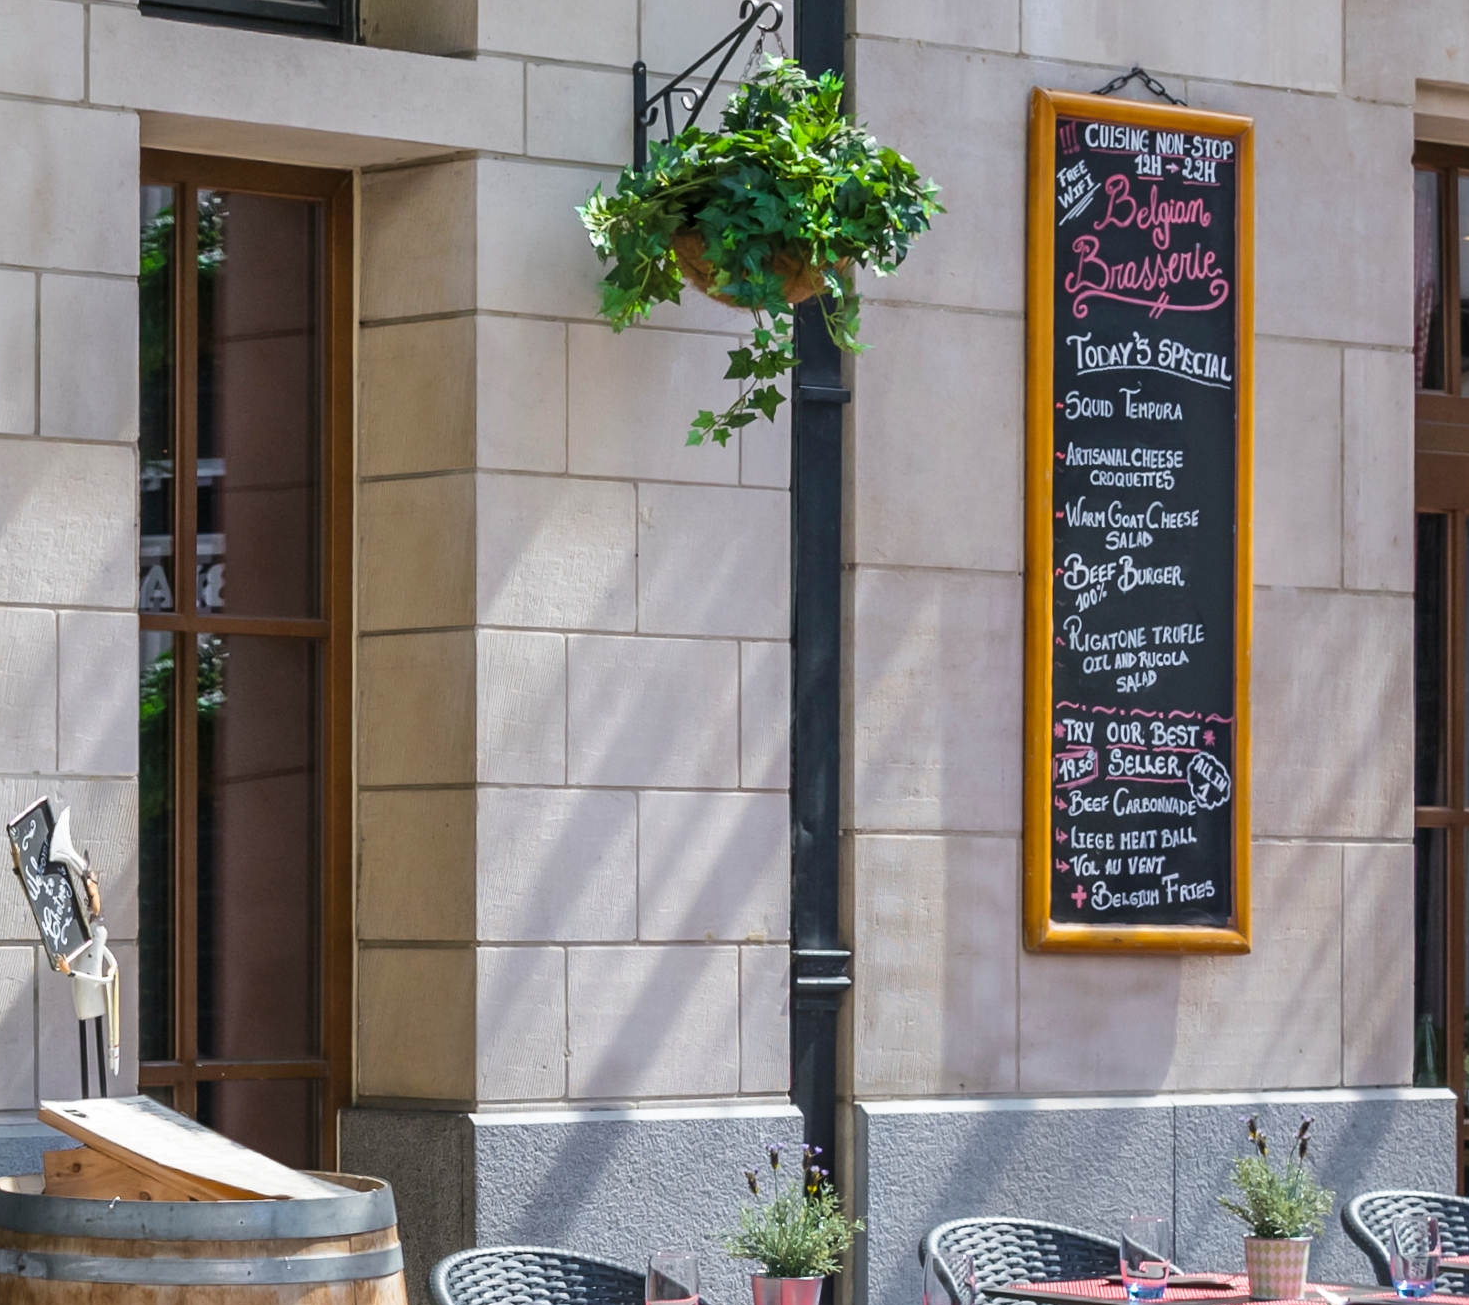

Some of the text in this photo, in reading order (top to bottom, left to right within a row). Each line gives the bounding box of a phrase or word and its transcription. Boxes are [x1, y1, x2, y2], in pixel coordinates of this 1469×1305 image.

[1085, 123, 1150, 153] CUISINE
[1156, 132, 1234, 160] NON-STOP
[1056, 159, 1089, 188] FREE
[1134, 154, 1217, 183] 12H 22H
[1058, 173, 1096, 210] WIFI
[1093, 173, 1213, 251] Belgian
[1065, 235, 1223, 293] Brasserie
[1066, 331, 1233, 382] TODAY'S SPECIAL
[1065, 387, 1183, 421] SQUID TEMPURA
[1065, 442, 1184, 469] ARTISANAL CHEESE
[1090, 470, 1176, 490] CROQUETTES
[1065, 496, 1200, 529] WARM GOAT CHEESE
[1105, 531, 1154, 550] SALAD
[1063, 553, 1185, 593] BEEF BURGER
[1075, 582, 1108, 613] 100%
[1063, 615, 1205, 652] RIGATONE TRUFLE
[1082, 649, 1190, 674] OIL AND RUCOLA
[1116, 669, 1158, 693] SALAD
[1062, 718, 1200, 747] TRY OUR BEST
[1107, 748, 1183, 777] SELLER
[1193, 757, 1229, 793] ALL IN
[1068, 787, 1197, 817] BEEF CARBONNADE
[1070, 825, 1197, 851] LIEGE MEAT BALL
[1069, 853, 1166, 876] VOL AU VENT
[1091, 872, 1216, 911] BELGIUM FRIES
